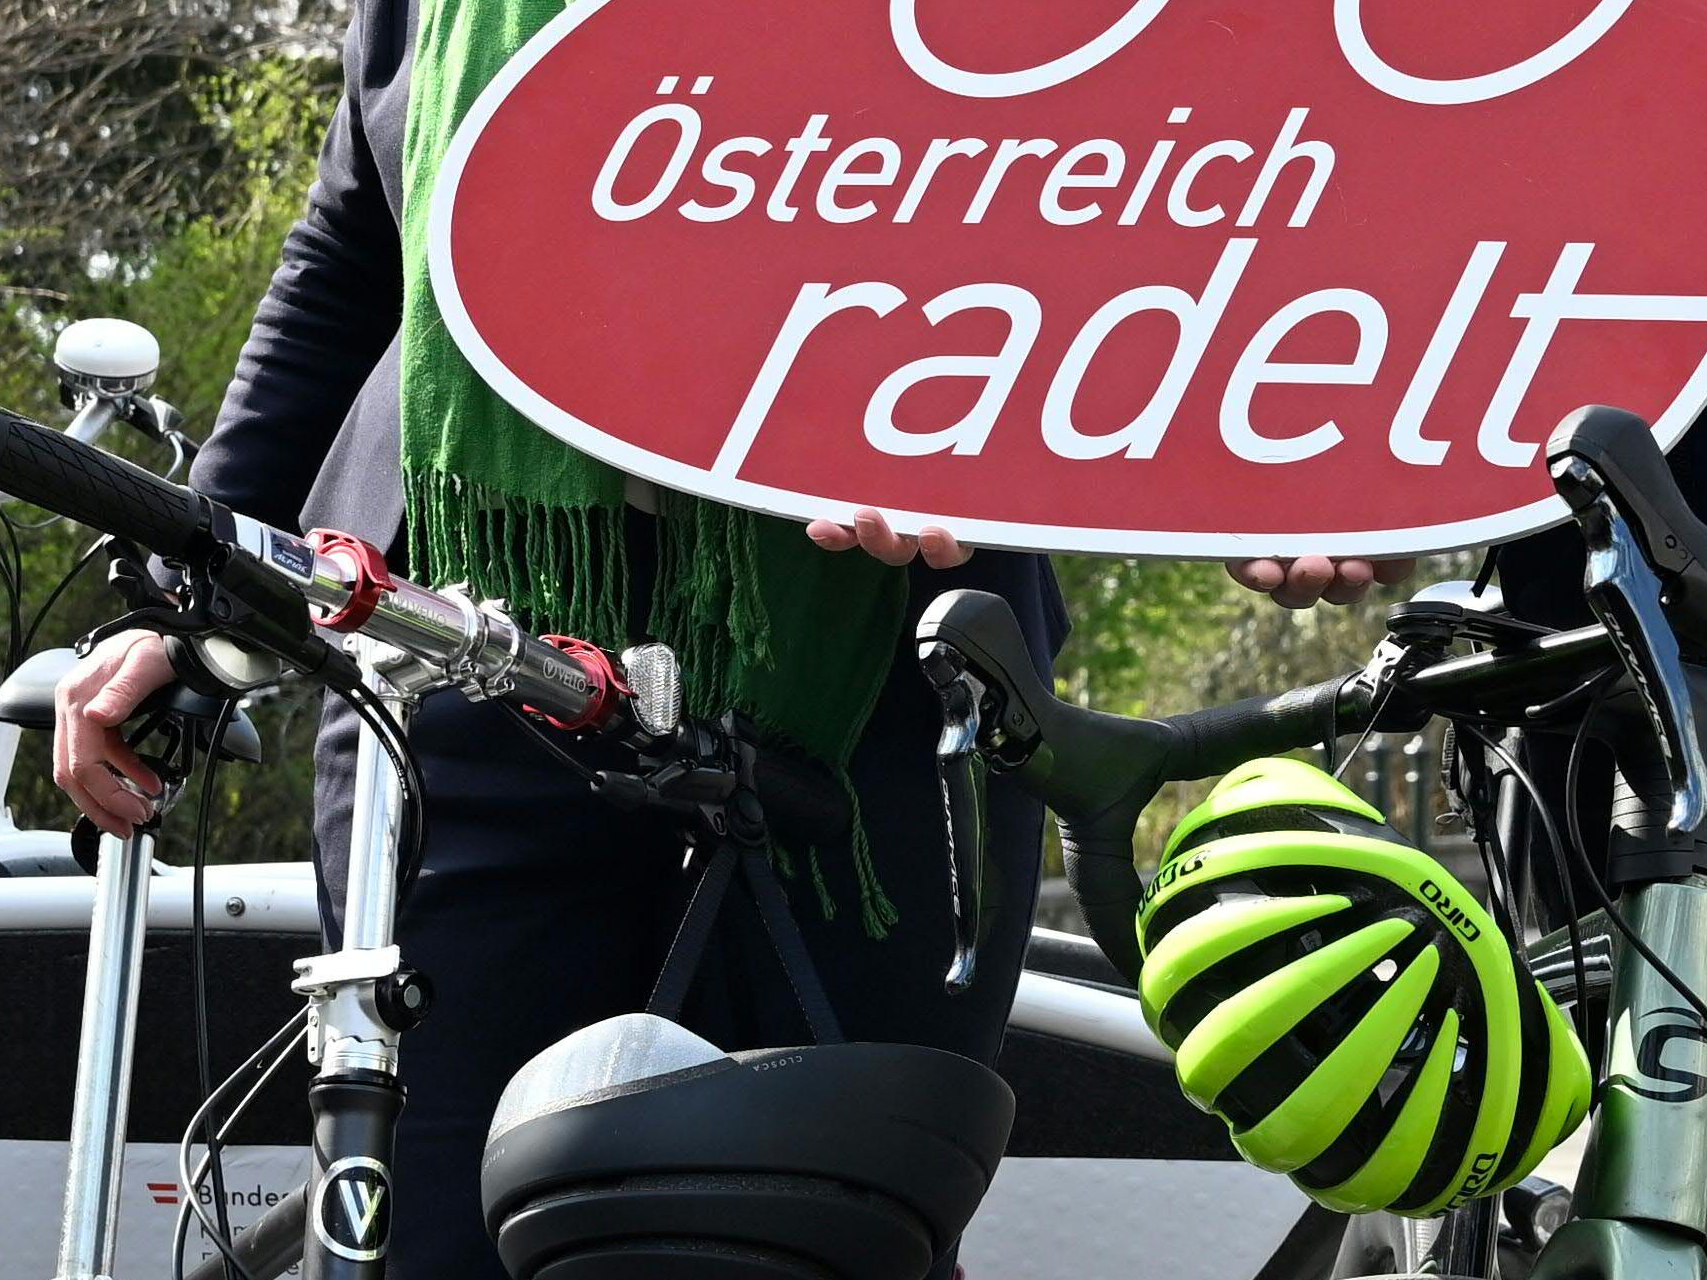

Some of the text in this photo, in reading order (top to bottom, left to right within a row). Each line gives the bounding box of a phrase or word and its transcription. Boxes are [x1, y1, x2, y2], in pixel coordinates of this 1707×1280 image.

[589, 75, 1336, 230] Österreich
[558, 669, 587, 693] VELLO
[1418, 878, 1481, 942] GIRO
[752, 1054, 804, 1072] CLOSCA
